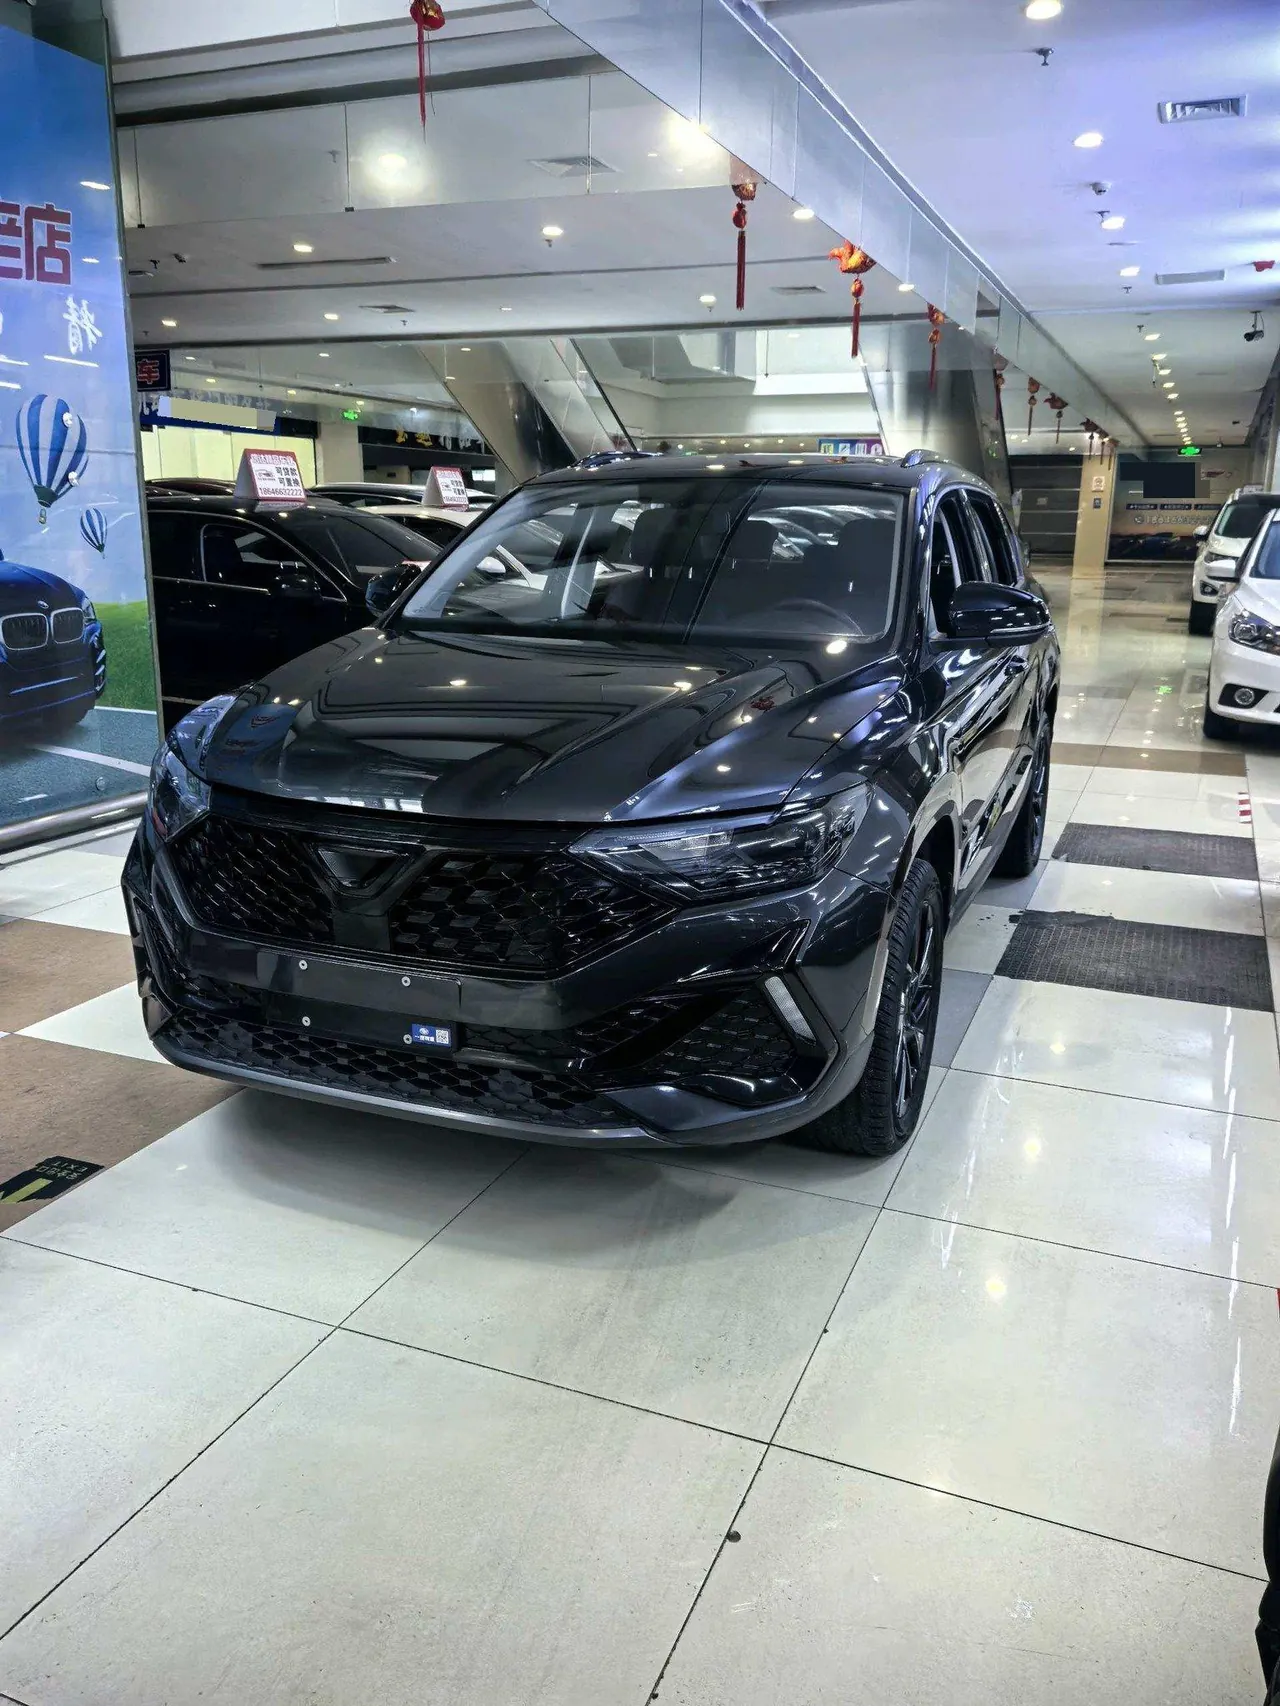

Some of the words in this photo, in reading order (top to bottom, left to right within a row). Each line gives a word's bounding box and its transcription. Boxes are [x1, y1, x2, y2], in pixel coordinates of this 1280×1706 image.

[275, 466, 298, 477] 可贷款
[278, 477, 301, 488] 可置换
[259, 487, 303, 497] 18646632222
[53, 1161, 88, 1173] EXIT
